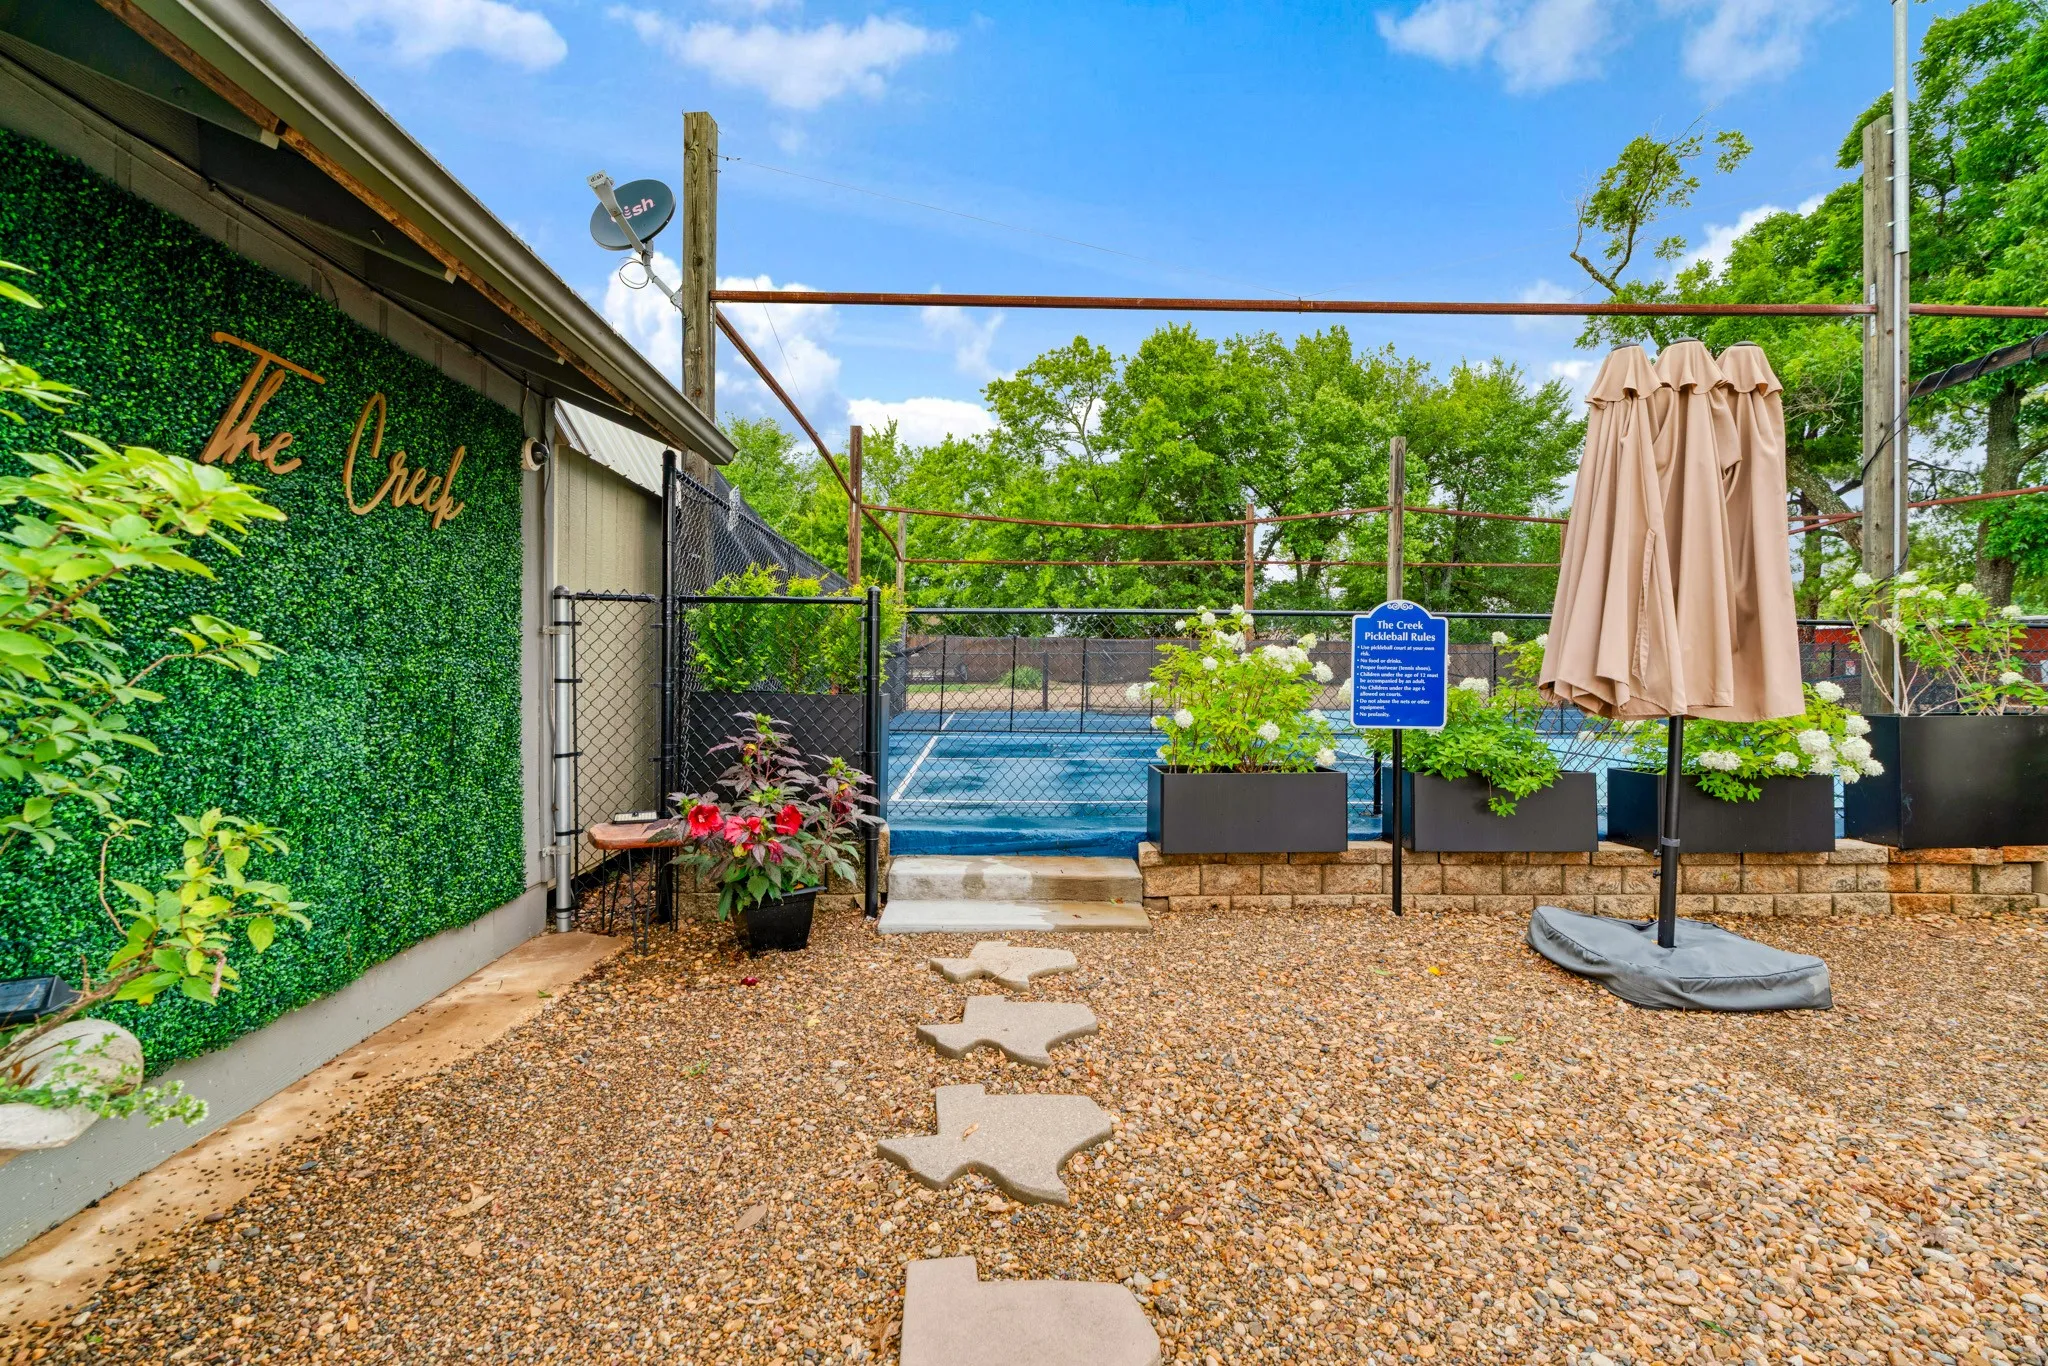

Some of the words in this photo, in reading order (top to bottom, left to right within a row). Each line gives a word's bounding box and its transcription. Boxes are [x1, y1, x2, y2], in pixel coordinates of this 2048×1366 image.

[200, 331, 325, 474] The
[344, 391, 466, 530] Creek
[1377, 621, 1394, 629] The
[1396, 621, 1424, 630] Creek
[1365, 632, 1408, 641] Pickleball
[1411, 633, 1436, 642] Rules
